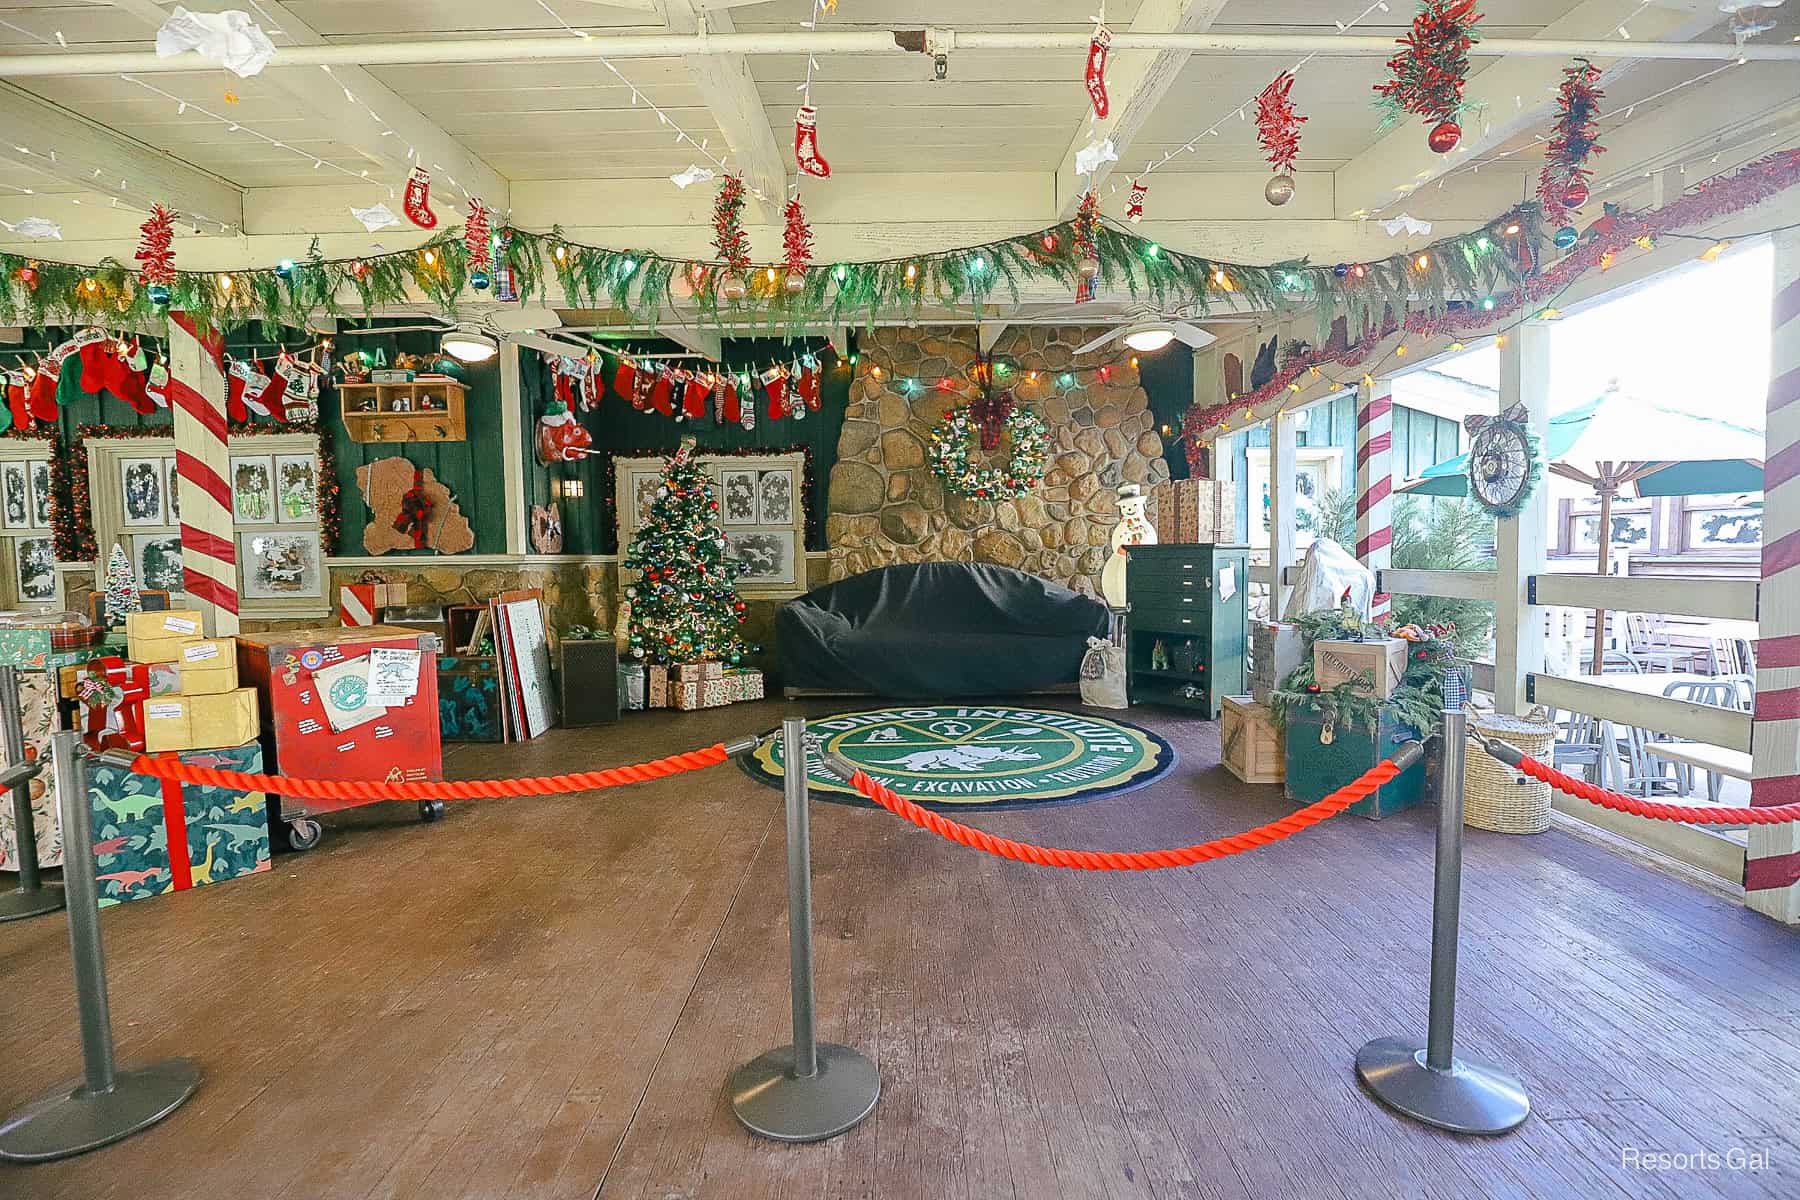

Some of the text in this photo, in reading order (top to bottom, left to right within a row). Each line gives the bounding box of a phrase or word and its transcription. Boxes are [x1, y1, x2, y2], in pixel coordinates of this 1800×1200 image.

[817, 709, 1134, 753] DINO INSTITUTE
[911, 776, 1037, 794] EXCAVATION
